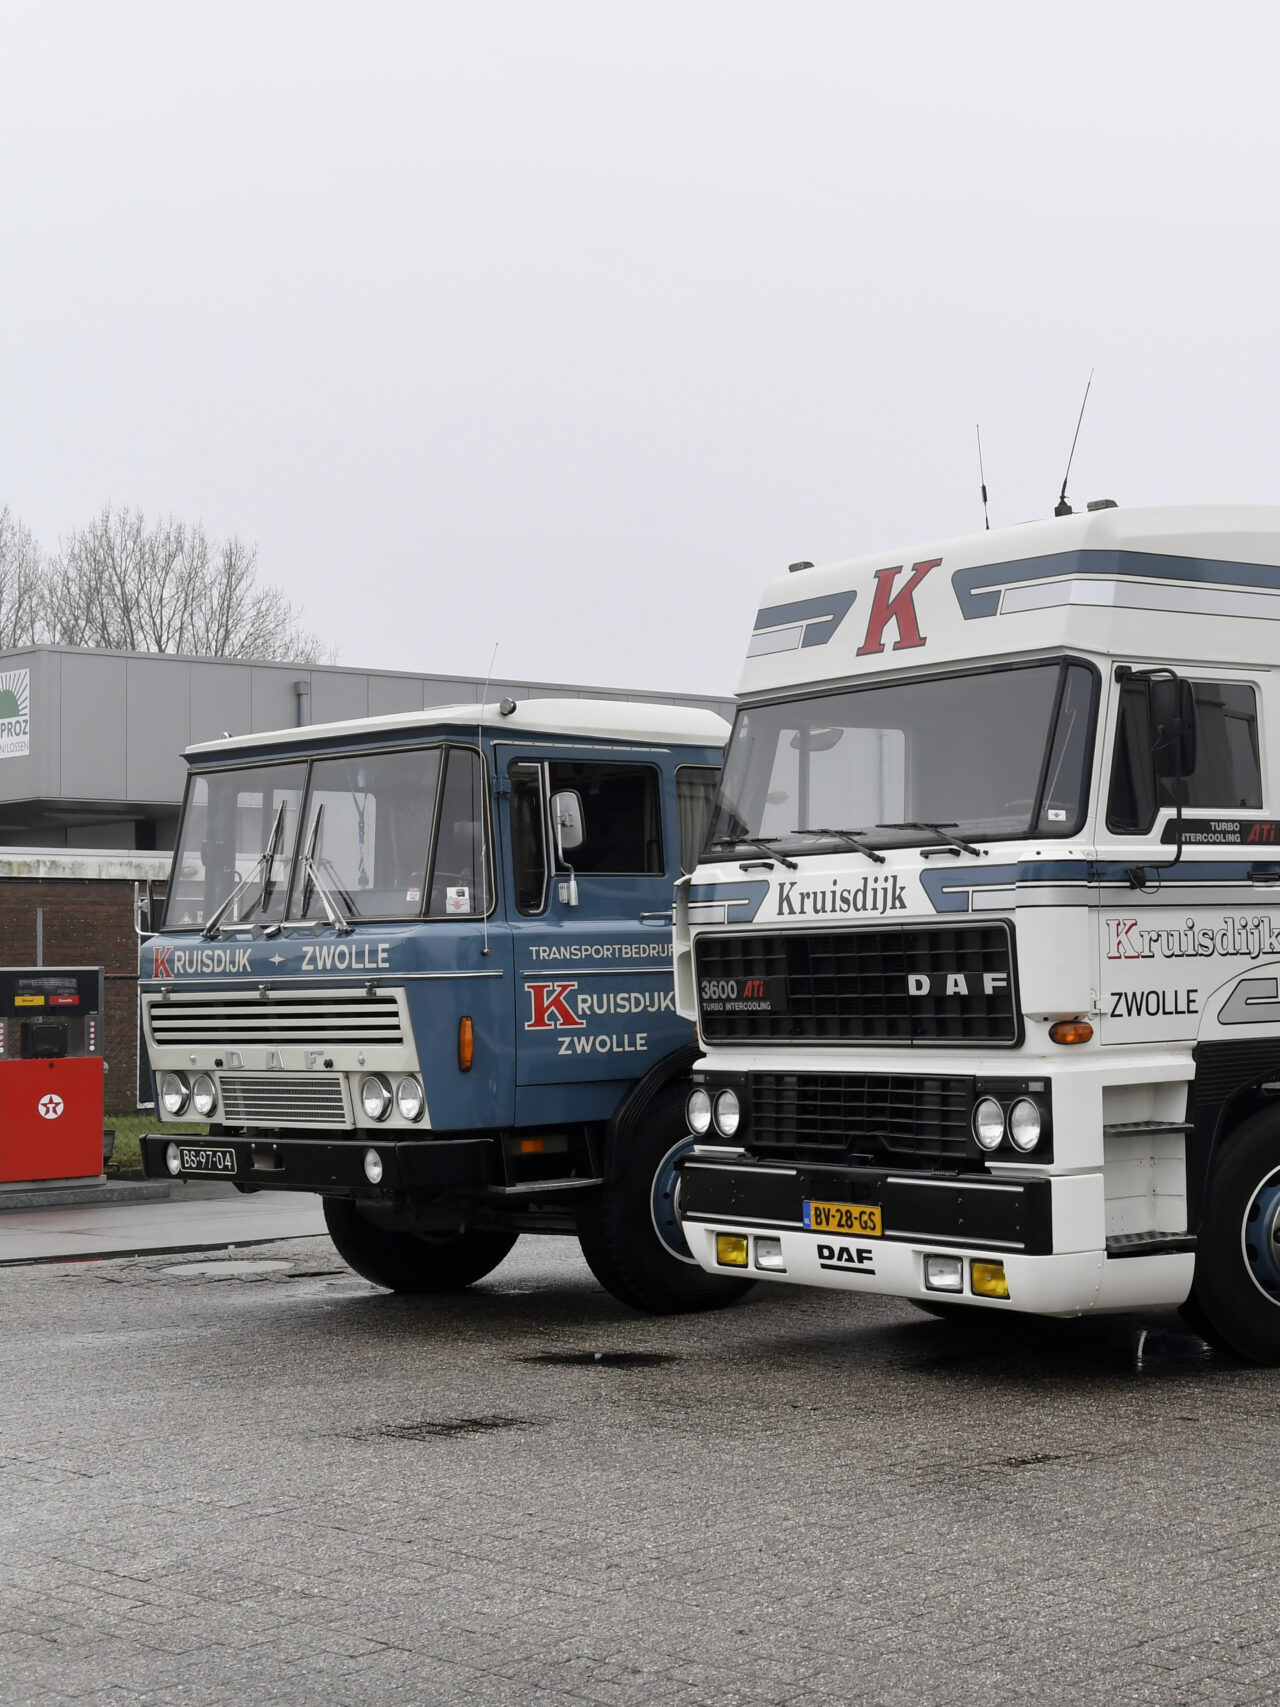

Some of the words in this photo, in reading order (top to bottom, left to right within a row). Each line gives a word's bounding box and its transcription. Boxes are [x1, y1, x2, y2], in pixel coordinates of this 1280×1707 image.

[855, 557, 943, 658] K
[1210, 822, 1240, 831] TURBO
[776, 874, 908, 916] Kruisdijk
[152, 946, 252, 979] KRUISDIJK
[301, 943, 390, 971] ZWOLLE
[701, 980, 738, 1000] 3600
[907, 972, 1008, 996] DAF
[524, 981, 677, 1031] KRUISDIJK
[702, 1002, 724, 1011] TURBO
[725, 1001, 771, 1011] INTERCOOLING
[1110, 988, 1199, 1018] ZWOLLE
[557, 1033, 648, 1056] ZWOLLE
[225, 1050, 325, 1070] DAF
[813, 1206, 877, 1231] BV-28-GS
[817, 1243, 874, 1264] DAF
